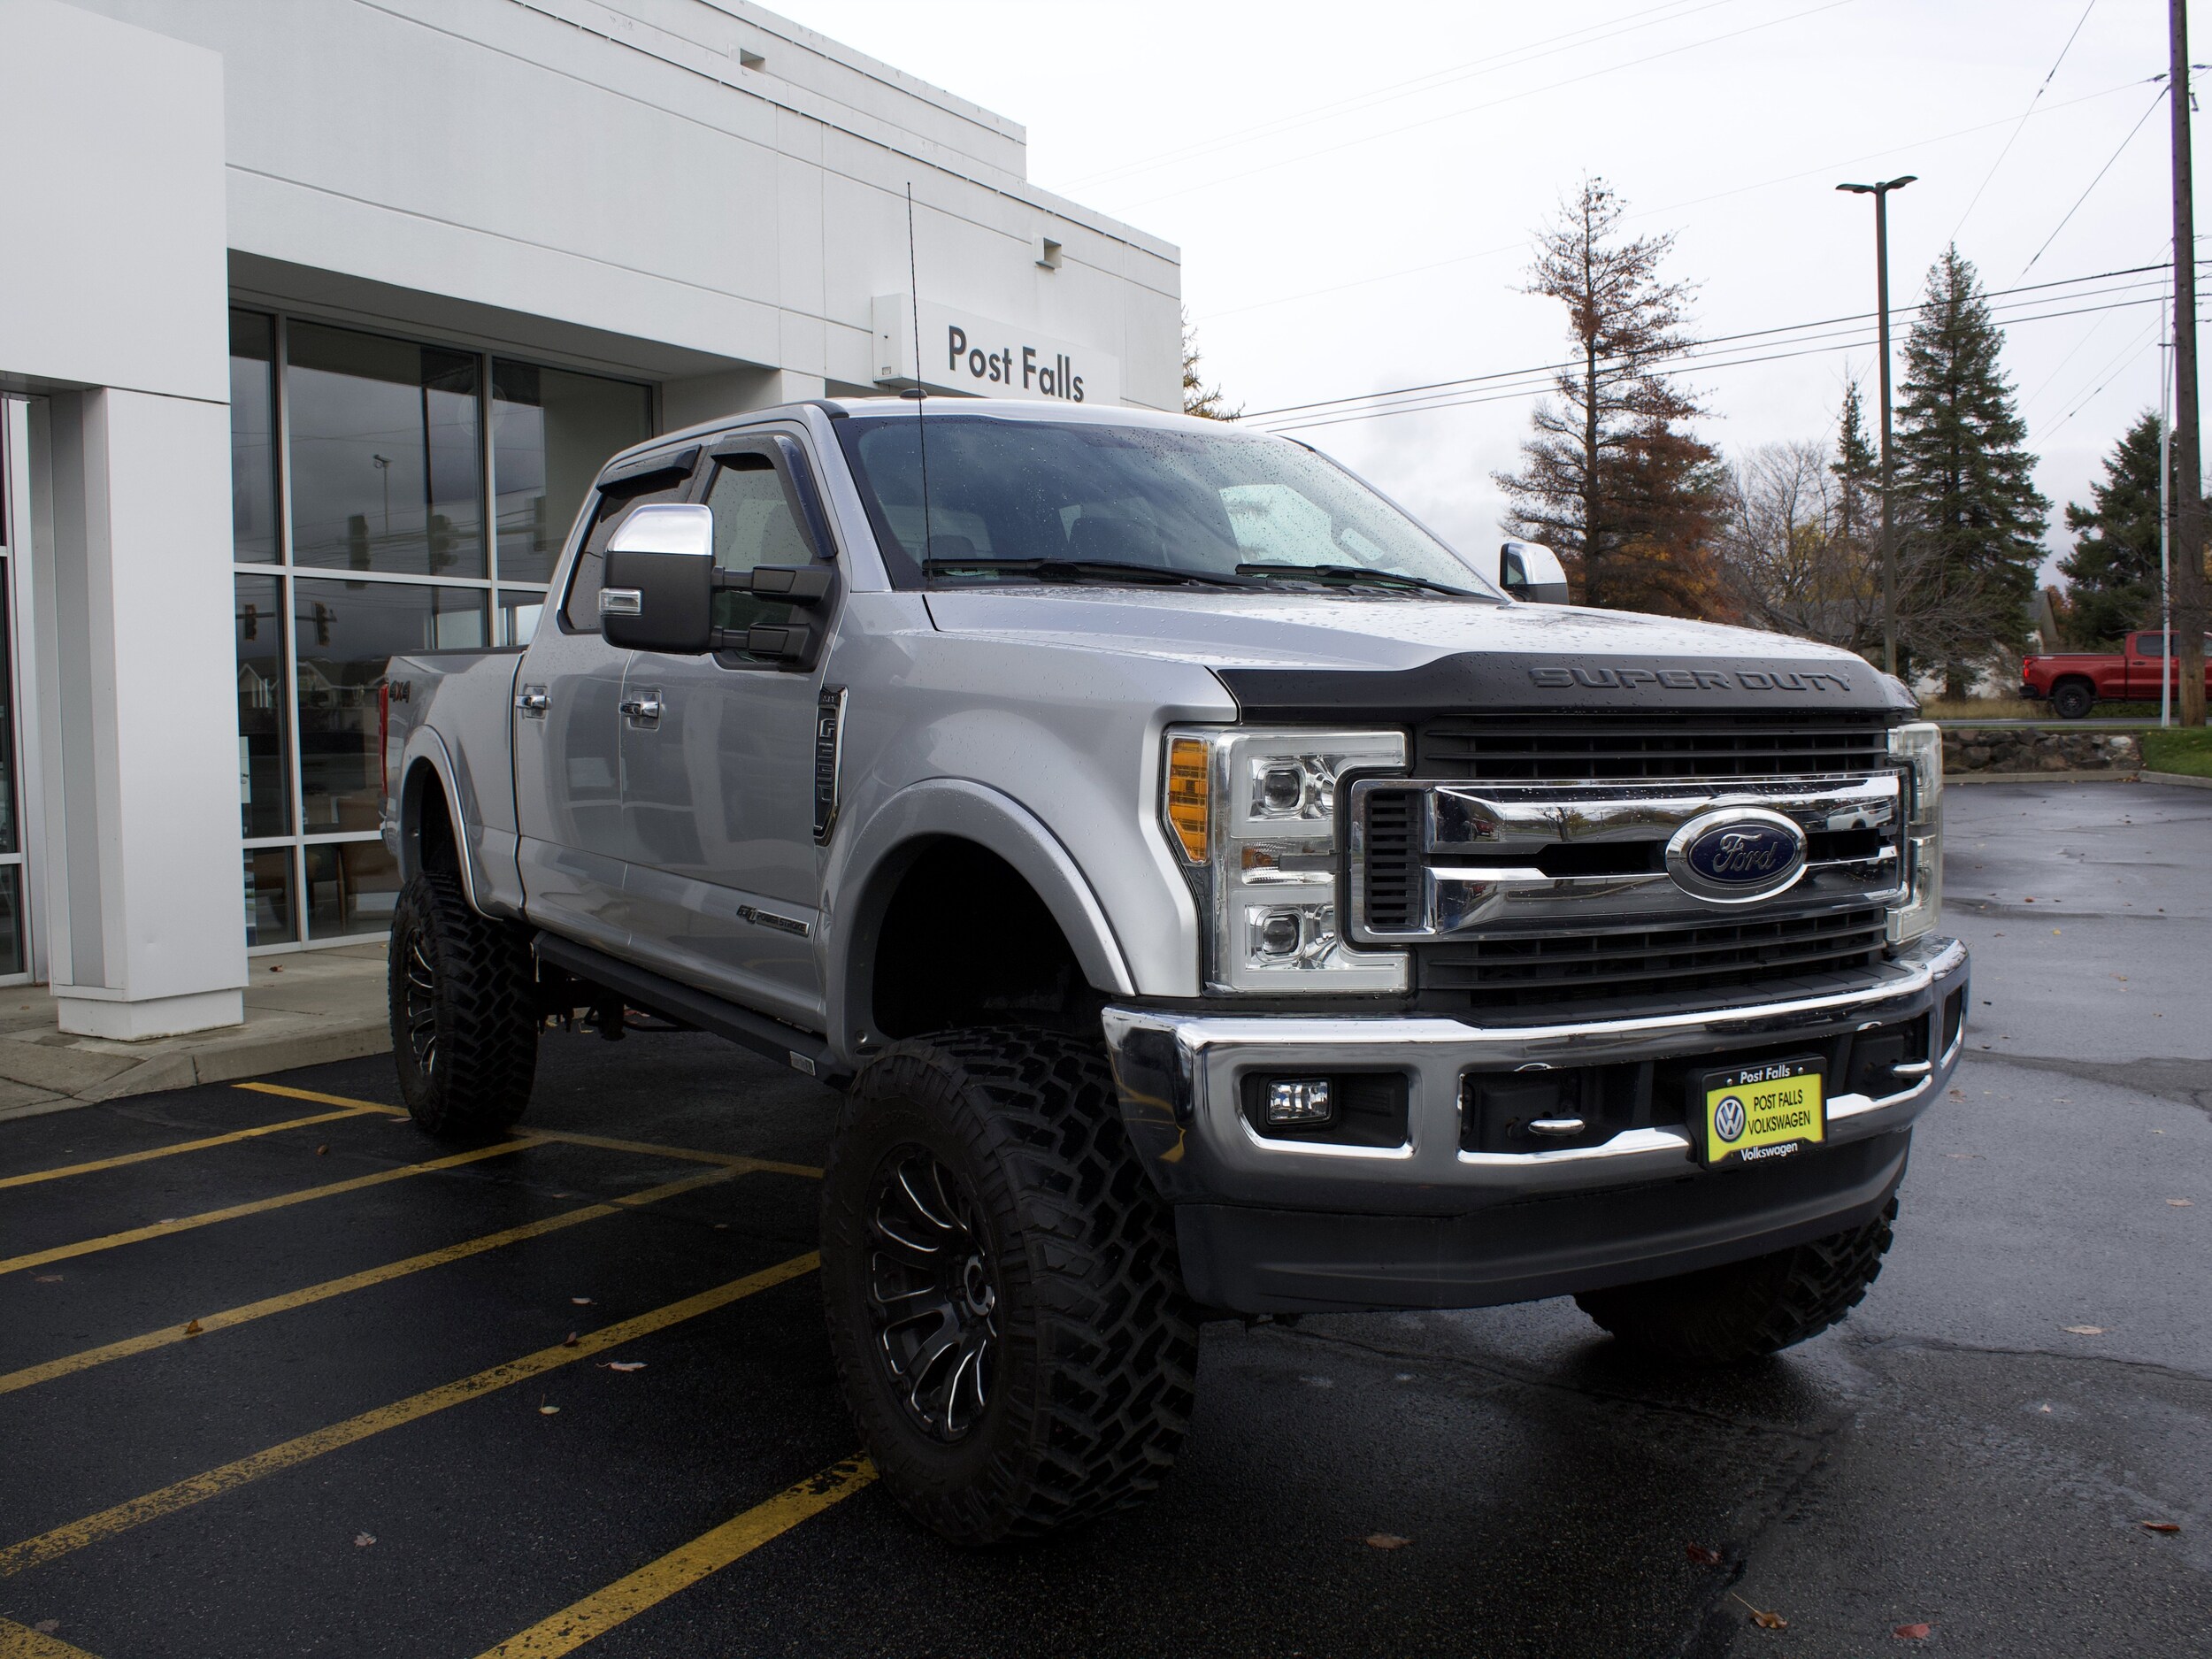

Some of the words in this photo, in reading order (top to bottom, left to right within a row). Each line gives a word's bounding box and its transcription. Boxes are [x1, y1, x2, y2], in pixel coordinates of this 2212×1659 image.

[949, 325, 1013, 385] Post
[1022, 345, 1085, 403] Falls
[1528, 667, 1732, 690] SUPER
[1735, 671, 1851, 692] DUTY
[1712, 833, 1778, 873] Ford
[1740, 1070, 1763, 1084] Post
[1765, 1064, 1791, 1080] Falls
[1754, 1094, 1777, 1112] POST
[1778, 1089, 1803, 1108] FALLS
[1747, 1110, 1811, 1135] VOLKSWAGEN
[1740, 1142, 1798, 1162] Volkswagen
